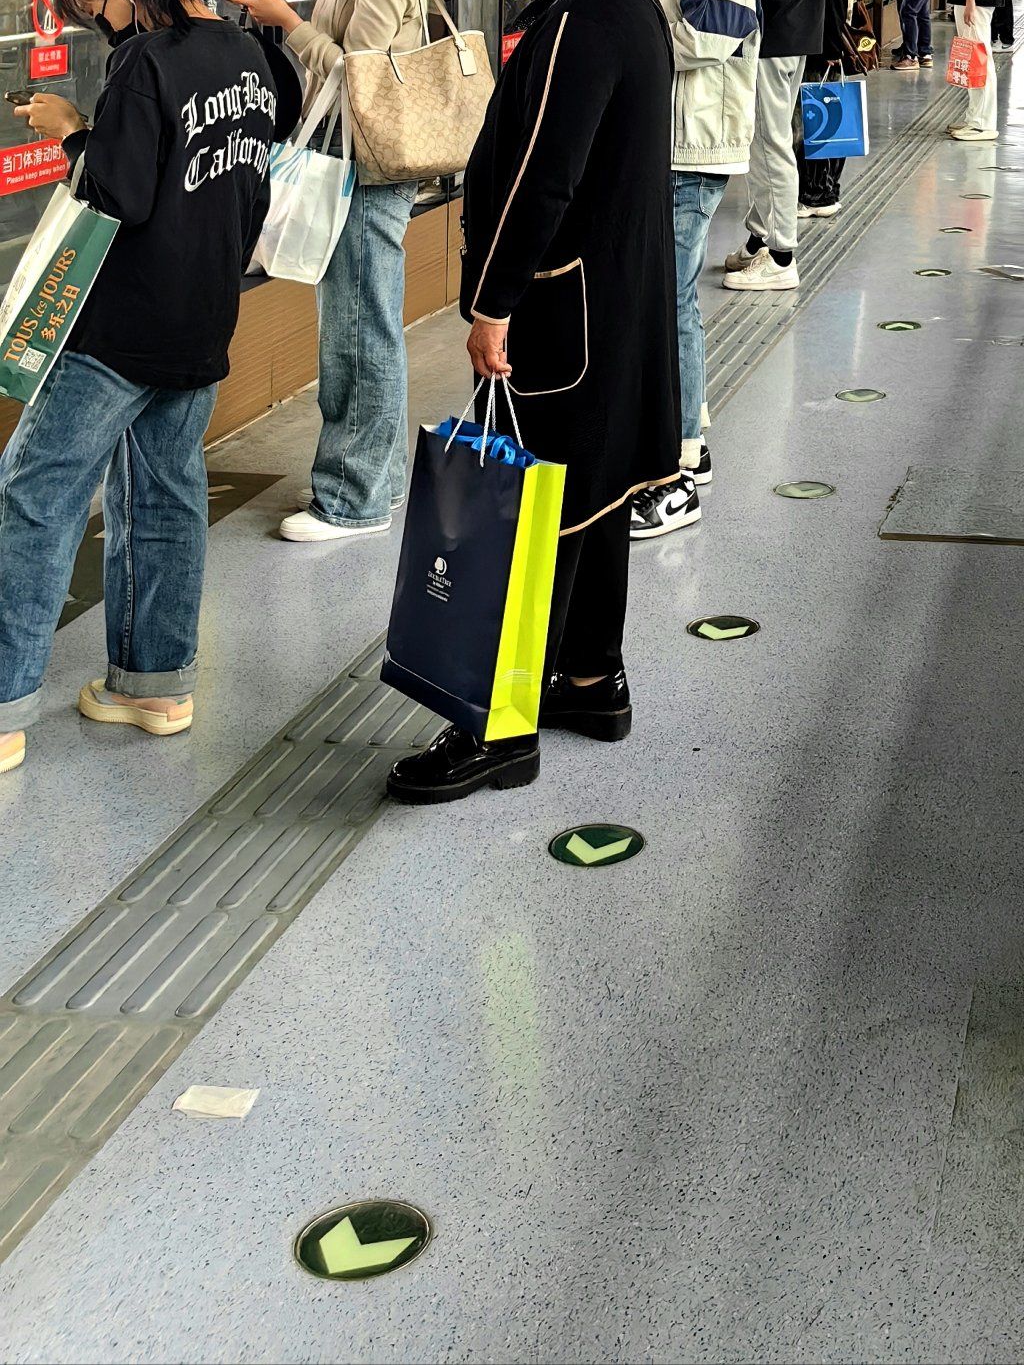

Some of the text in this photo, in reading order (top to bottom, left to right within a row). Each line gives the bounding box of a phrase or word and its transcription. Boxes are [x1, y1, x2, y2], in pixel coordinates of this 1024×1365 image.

[240, 71, 277, 126] Bea
[6, 175, 25, 185] Please
[25, 171, 38, 180] keep
[39, 168, 52, 177] away
[3, 316, 39, 362] TOUS
[38, 246, 77, 304] JOURS
[40, 284, 81, 343] 多乐之日
